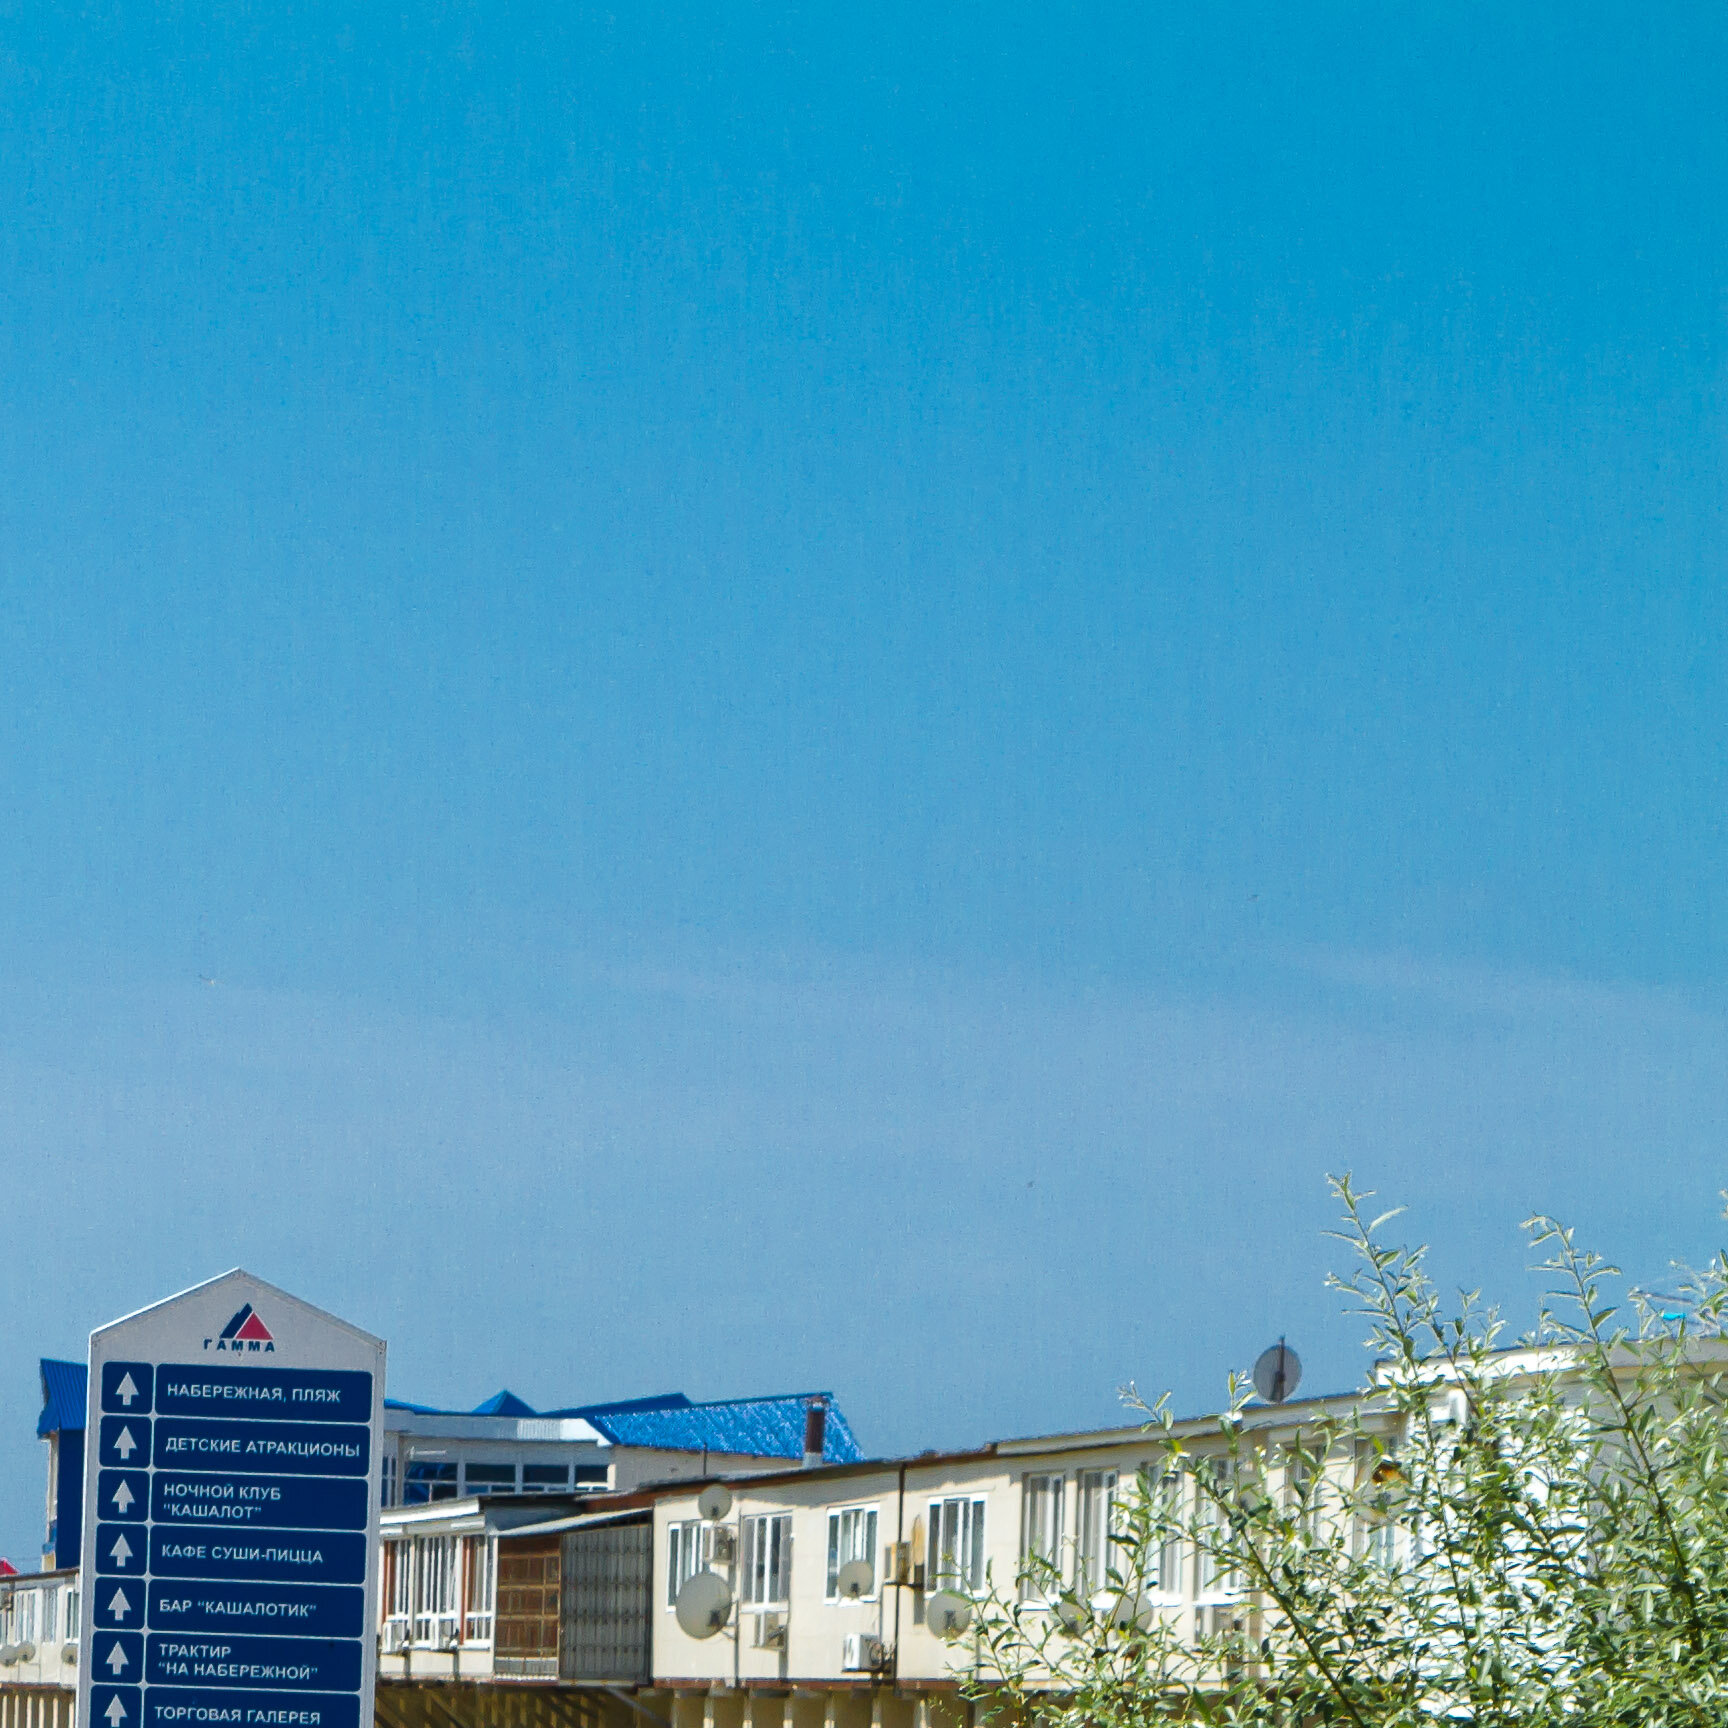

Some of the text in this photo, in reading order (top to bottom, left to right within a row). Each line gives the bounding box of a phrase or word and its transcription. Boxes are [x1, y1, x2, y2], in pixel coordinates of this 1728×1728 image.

[203, 1339, 275, 1353] ГАММА
[167, 1383, 341, 1403] НАБЕРЕЖНАЯ, ПЛЯЖ
[165, 1437, 360, 1457] ДЕТСКИЕ АТРАКЦИОНЫ
[163, 1483, 281, 1500] НОЧНОЙ КЛУБ
[161, 1544, 323, 1564] КАФЕ СУШИ-ПИЦЦА
[159, 1599, 192, 1613] БАР
[158, 1643, 232, 1659] ТРАКТИР
[154, 1706, 321, 1725] ТОРГОВАЯ ГАЛЕРЕЯ
